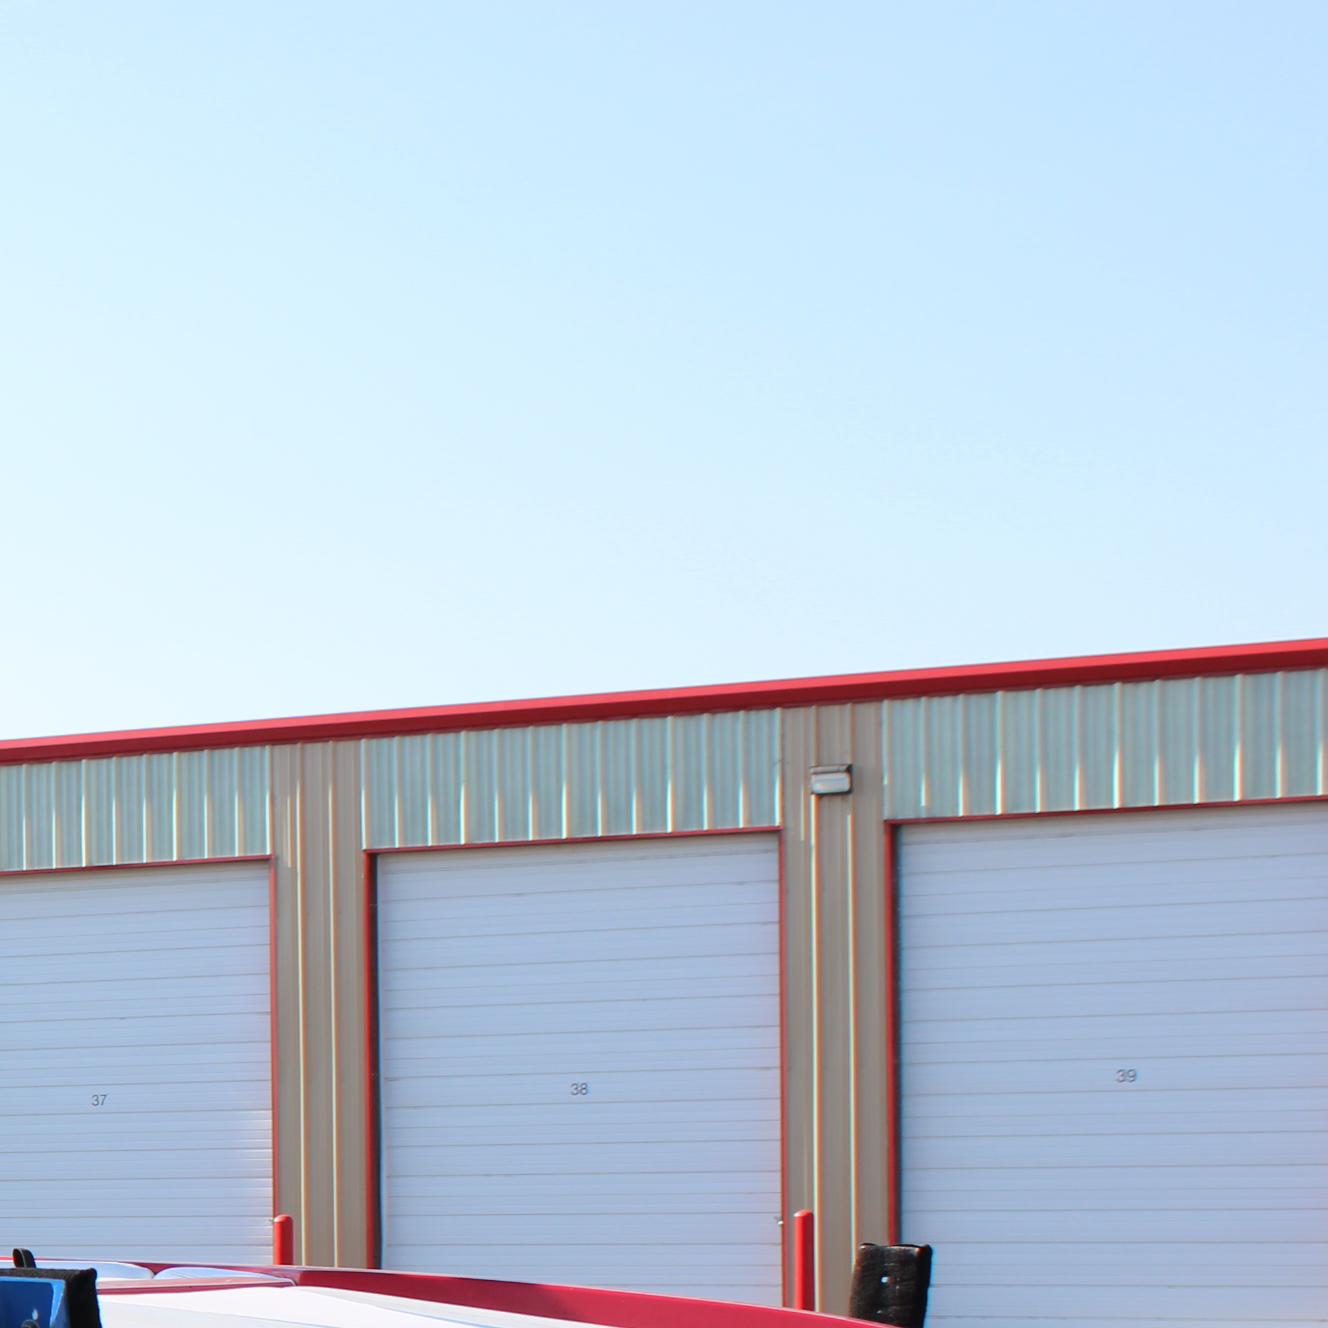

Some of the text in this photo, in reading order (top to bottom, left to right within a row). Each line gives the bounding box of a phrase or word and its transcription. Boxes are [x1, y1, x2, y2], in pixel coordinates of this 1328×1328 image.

[1115, 1068, 1137, 1083] 39
[570, 1082, 588, 1096] 38
[91, 1094, 107, 1107] 37
